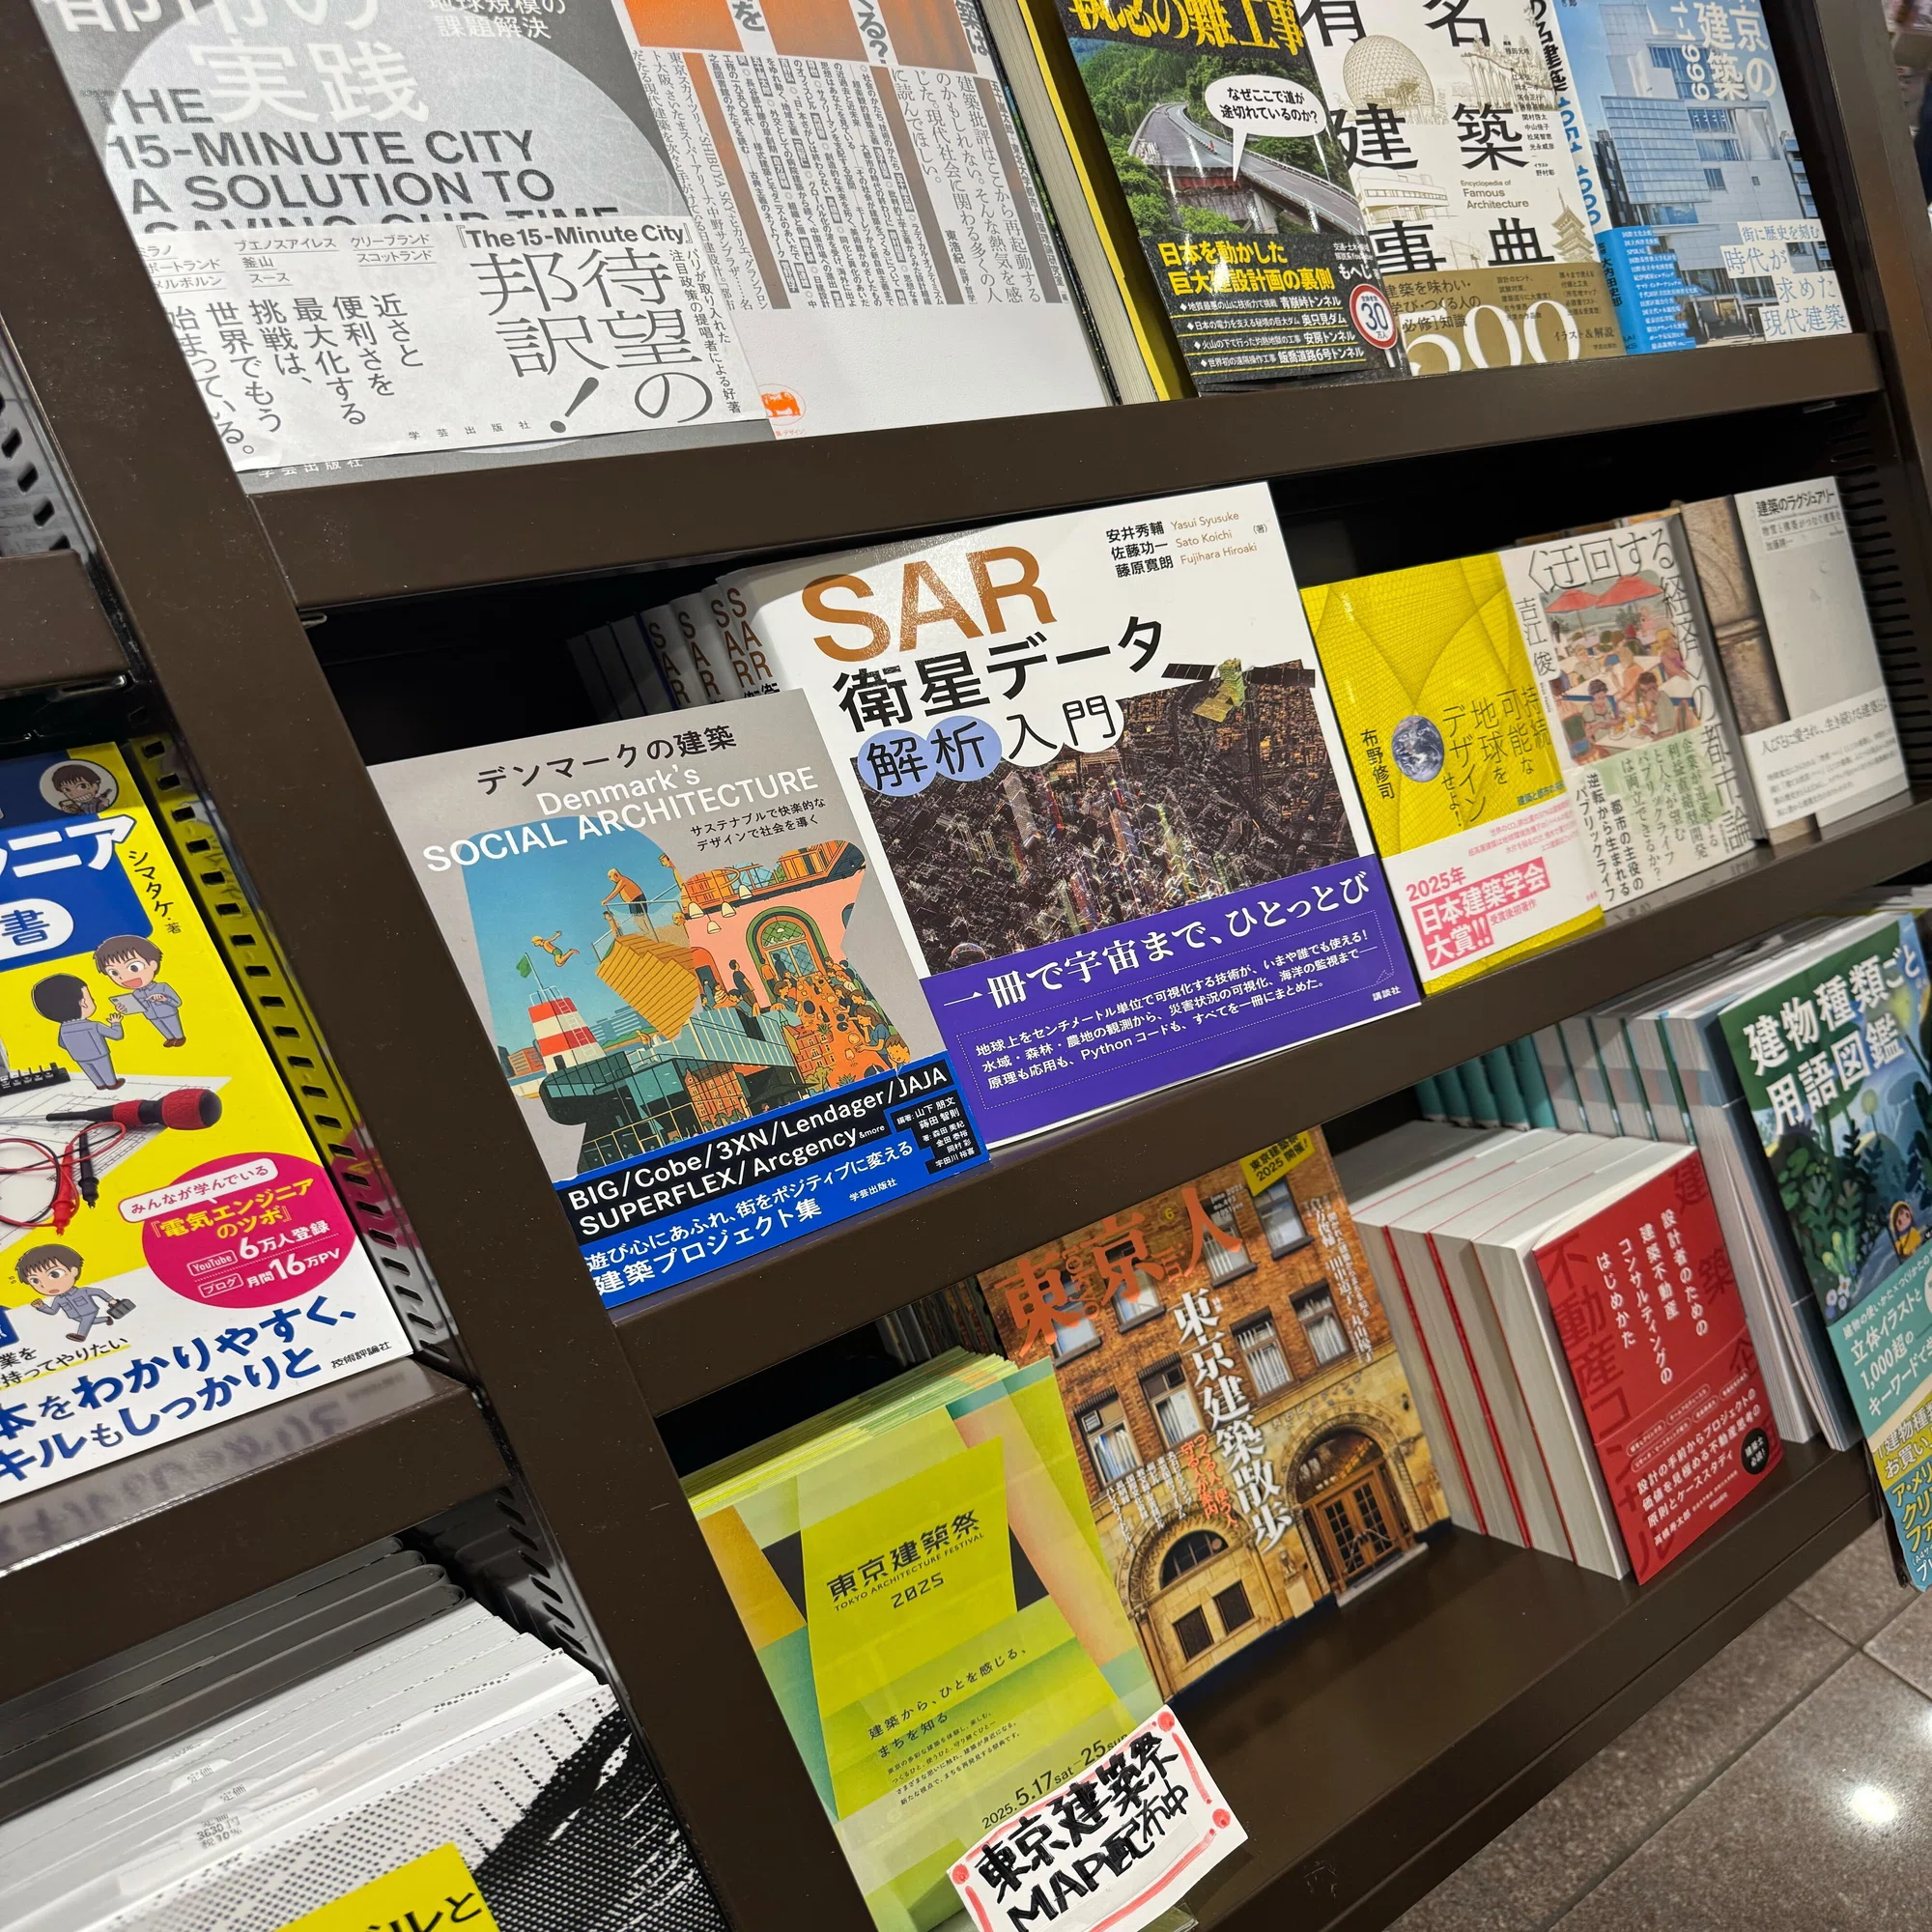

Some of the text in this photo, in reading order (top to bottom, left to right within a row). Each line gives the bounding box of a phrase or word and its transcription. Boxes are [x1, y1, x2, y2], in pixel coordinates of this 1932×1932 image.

[437, 15, 552, 40] 課題解決
[732, 0, 766, 33] を
[1693, 2, 1748, 101] 建築
[81, 89, 214, 125] THE
[194, 39, 429, 124] 実践
[1219, 103, 1319, 125] 途切れているのか?
[1226, 86, 1305, 105] なぜここで道が
[107, 129, 533, 170] 15-MINUTE CITY
[892, 69, 942, 184] に読んでほしい。
[132, 169, 555, 214] A SOLUTION TO
[914, 70, 1004, 304] じた。現代社会に関わる多くの人
[936, 72, 1024, 304] のかもしれない。そんな熱気を感
[956, 74, 1041, 303] 建築批評はここから再起動する
[1463, 188, 1506, 198] Famous
[1466, 199, 1529, 210] Architecture
[146, 258, 221, 274] ポートランド
[235, 237, 336, 252] ブエノスアイレス
[243, 255, 274, 269] 釜山
[350, 233, 430, 247] クリーブランド
[355, 249, 433, 263] スコットランド
[520, 226, 638, 245] 15-Minute
[1158, 240, 1289, 268] 日本を動かした
[1723, 245, 1788, 274] 時代が
[1742, 223, 1820, 243] 街に歴史を刻む
[152, 274, 222, 292] メルボルン
[249, 272, 291, 285] スース
[686, 248, 731, 344] パリが取り入れた
[1338, 262, 1373, 281] もへじ
[1776, 275, 1836, 300] 求めた
[249, 299, 313, 384] 挑戦は、
[332, 294, 395, 397] 便利さを
[373, 292, 424, 369] 近さと
[578, 246, 713, 423] 待望の
[668, 248, 742, 414] 注目政策の提唱者による好著
[1361, 301, 1389, 331] 30
[1761, 303, 1847, 337] 現代建築
[206, 302, 282, 433] 世界でもう
[293, 297, 367, 426] 最大化する
[408, 419, 531, 440] 学芸出版社
[1106, 511, 1239, 544] 安井秀輔 Yasui Syusuke
[1111, 529, 1233, 561] 佐藤功一 Sato Koichi
[1115, 542, 1258, 579] 藤原寛朗 Fujihara Hiroaki
[726, 587, 774, 681] SAR
[800, 544, 1058, 664] SAR
[648, 622, 692, 706] SAR
[677, 611, 722, 697] SAR
[710, 599, 755, 689] SAR
[832, 614, 1163, 733] 衛星データ
[477, 724, 737, 796] デンマークの建築
[865, 694, 1121, 792] 解析入門
[1359, 727, 1395, 800] 布野修司
[1442, 704, 1487, 823] デザイン
[1470, 696, 1509, 785] 地球を
[1496, 688, 1534, 775] 可能な
[423, 766, 819, 872] SOCIAL ARCHITECTURE
[535, 762, 701, 816] Denmark's
[690, 796, 826, 838] サステナブルで快楽的な
[1440, 772, 1463, 828] せよ!
[696, 813, 819, 852] デザインで社会を導く
[1576, 787, 1616, 902] パブリックライフ
[1586, 773, 1631, 897] 逆転から生まれる
[1610, 798, 1645, 892] 都市の主役の
[1405, 867, 1467, 902] 2025年
[1416, 863, 1548, 937] 日本建築学会
[1, 908, 51, 947] 書
[943, 870, 1371, 1010] 一冊で宇宙まで、ひとっとび
[1372, 984, 1402, 1002] 講談社
[1079, 1035, 1134, 1062] Python
[1765, 1013, 1906, 1143] 用語図鑑
[858, 1123, 886, 1140] &more
[130, 1164, 270, 1215] みんなが学んでいる
[848, 1177, 897, 1203] 学芸出版社
[1256, 1159, 1284, 1181] 2025
[587, 1141, 914, 1272] 遊び心にあふれ、街をポジティブに変える
[1164, 1207, 1175, 1220] 6
[192, 1219, 331, 1273] YouTube 6万人登録
[203, 1247, 342, 1295] ブログ 月間16万PV
[593, 1197, 823, 1296] 建築プロジェクト集
[995, 1186, 1244, 1357] 東京人
[1638, 1222, 1680, 1321] 建築不動産
[1660, 1208, 1709, 1337] 設計者のための
[1596, 1251, 1637, 1350] はじめかた
[1618, 1237, 1674, 1385] コンサルティングの
[1849, 1287, 1923, 1367] 立体イラストと
[2, 1334, 129, 1389] 持ってやりたい
[330, 1340, 393, 1371] 技術評論社
[1860, 1328, 1916, 1392] 1,000超の
[0, 1346, 323, 1482] キルもしっかりと
[1173, 1287, 1295, 1554] 東京建築散歩
[1635, 1387, 1757, 1496] 設計の手前からプロジェクトの
[1180, 1440, 1219, 1520] 守る人が案内
[1647, 1449, 1735, 1529] 原則とケーススタディ
[826, 1508, 980, 1604] 東京建築祭
[834, 1531, 985, 1612] TOKYO ARCHITECTURE FESTIVAL
[891, 1572, 945, 1609] 2025
[867, 1646, 1028, 1740] 建築から、ひとを感じる、
[877, 1711, 949, 1758] まちを知る
[974, 1730, 1179, 1904] 東京建築祭
